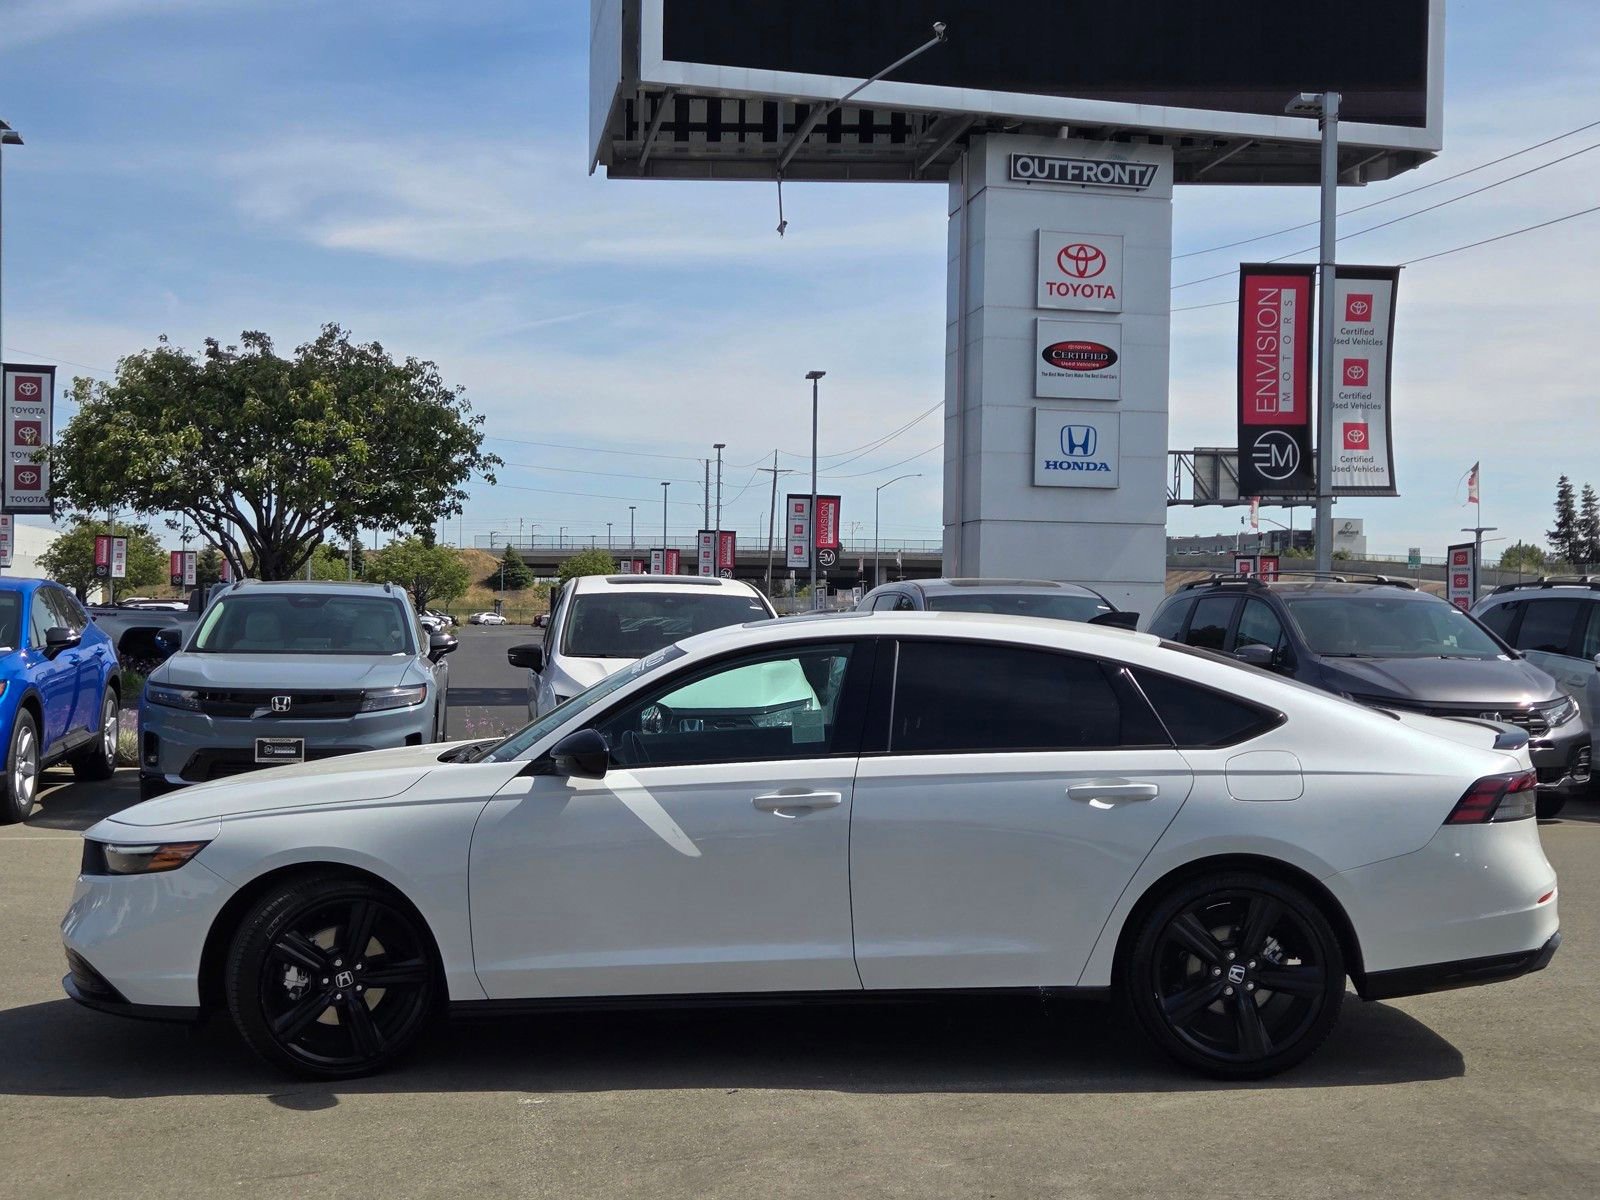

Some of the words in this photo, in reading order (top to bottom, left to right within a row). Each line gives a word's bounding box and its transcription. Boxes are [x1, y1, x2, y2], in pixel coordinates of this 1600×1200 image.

[1046, 281, 1116, 299] TOYOTA
[1340, 327, 1375, 336] Certified
[1352, 337, 1384, 346] Vehicles
[1256, 288, 1279, 412] ENVISION
[1282, 300, 1293, 402] MOTORS
[1052, 350, 1108, 361] CERTIFIED
[1338, 391, 1372, 400] Certified
[1350, 401, 1382, 410] Vehicles
[10, 406, 46, 415] TOYOTA
[1340, 455, 1375, 463] Certified
[1044, 460, 1112, 472] HONDA
[1352, 465, 1385, 473] Vehicles
[820, 502, 829, 544] ENVISION
